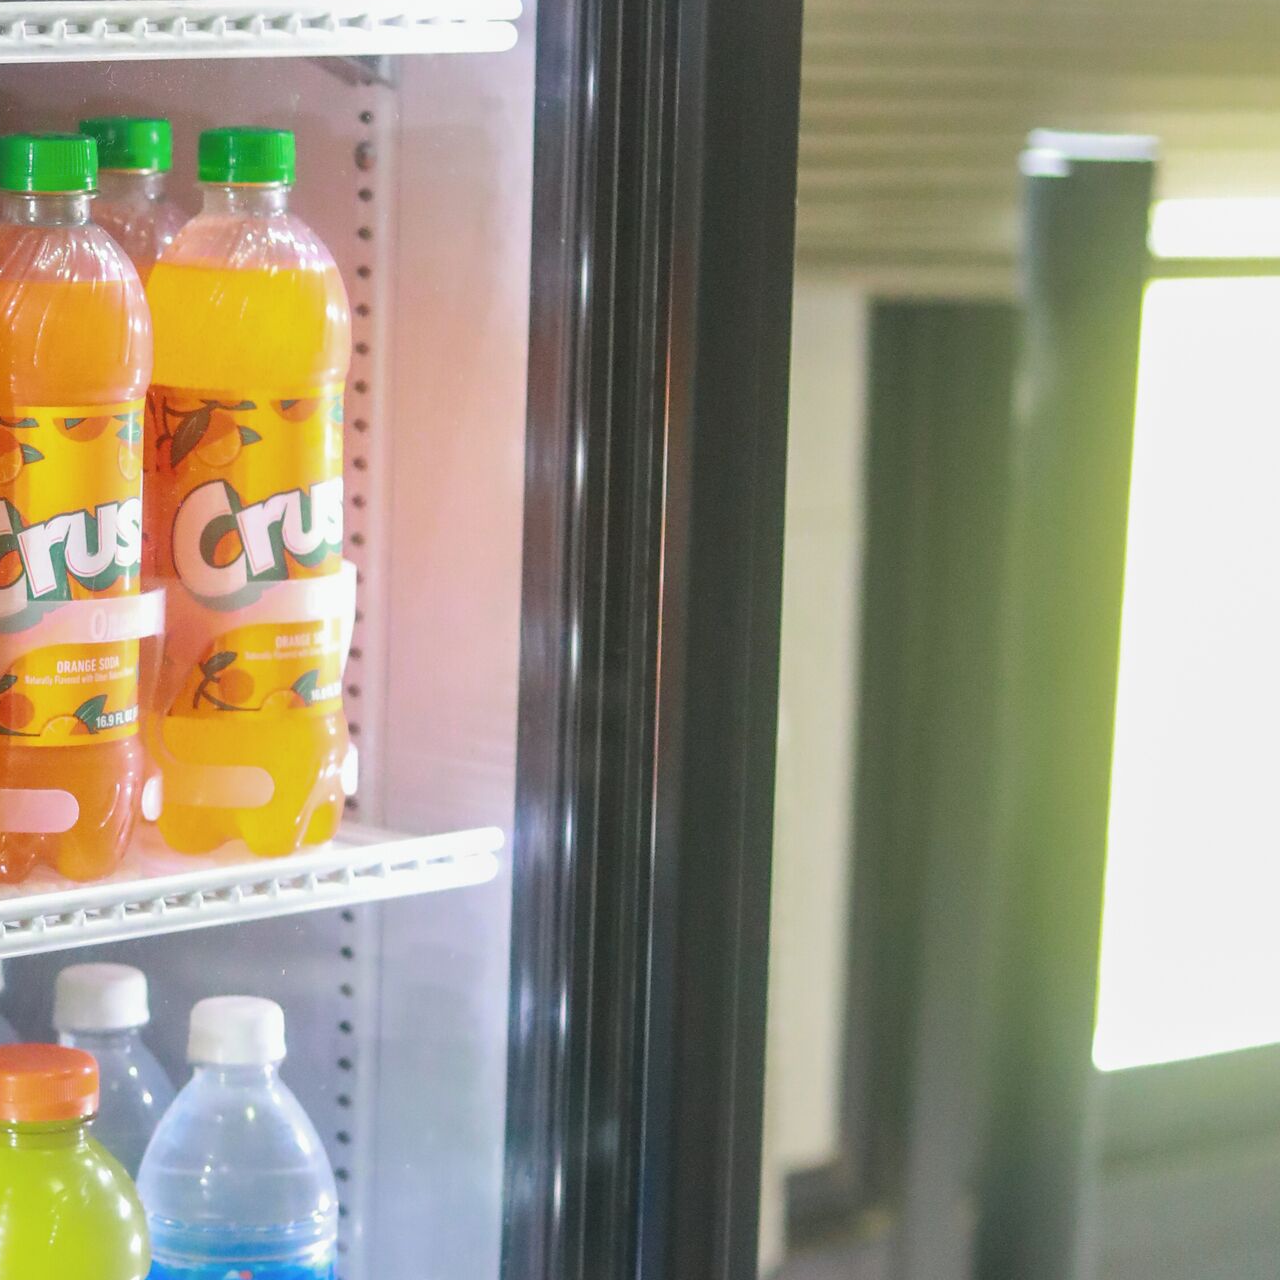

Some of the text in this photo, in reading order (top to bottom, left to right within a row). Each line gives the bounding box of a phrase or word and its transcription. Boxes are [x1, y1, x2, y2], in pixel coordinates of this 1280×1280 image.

[56, 659, 96, 674] ORANGE
[99, 655, 120, 671] SODA
[95, 714, 114, 729] 16.9
